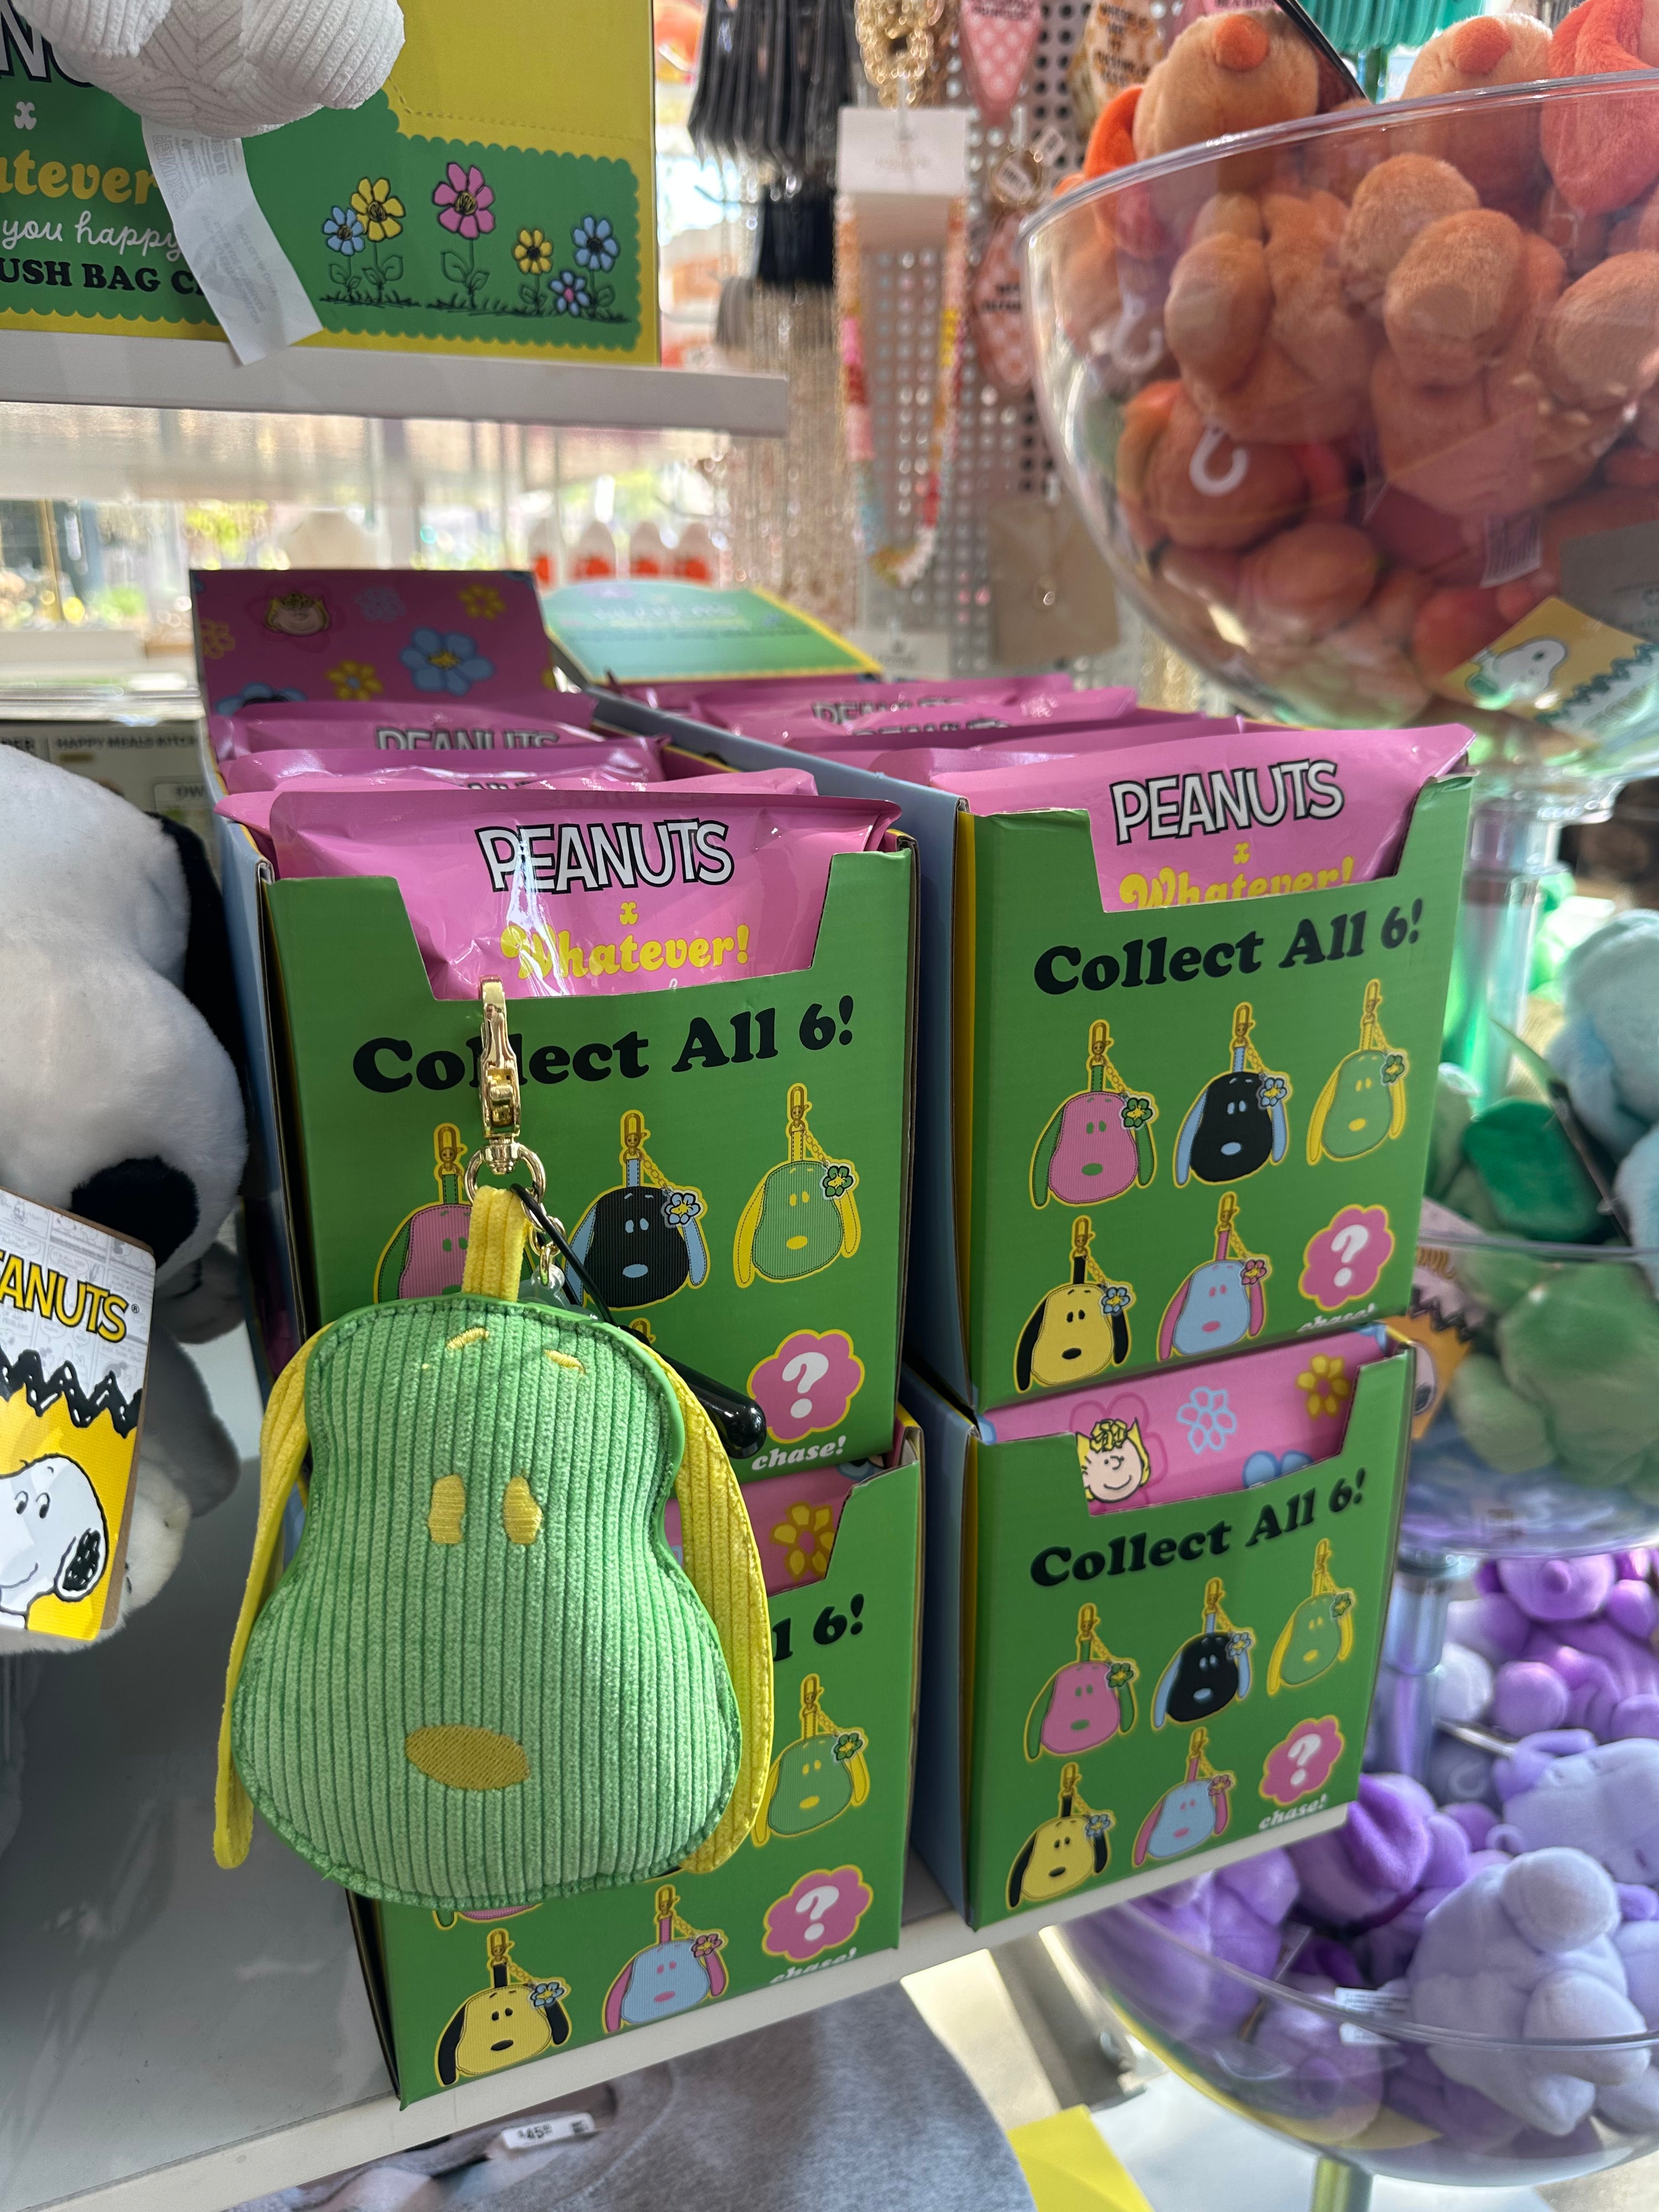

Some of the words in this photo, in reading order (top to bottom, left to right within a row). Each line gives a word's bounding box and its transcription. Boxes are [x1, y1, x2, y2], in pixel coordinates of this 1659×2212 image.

[2, 220, 62, 249] you
[75, 210, 182, 262] happy
[82, 263, 160, 292] BAG
[171, 270, 204, 295] C
[1109, 758, 1344, 846] PEANUTS
[475, 818, 734, 895] PEANUTS
[1119, 855, 1354, 910] Whatever!
[501, 924, 749, 979] Whatever!
[1034, 930, 1264, 995] Collect
[1279, 910, 1366, 968] All
[1381, 899, 1422, 950] 6!
[671, 1007, 778, 1073] All
[799, 995, 854, 1051] 6!
[0, 1248, 139, 1343] ANUTS®
[752, 1435, 846, 1470] chase!
[1030, 1520, 1232, 1587] Collect
[1245, 1487, 1315, 1546] All
[1329, 1467, 1365, 1512] 6!
[813, 1593, 864, 1645] 6!
[1259, 1793, 1327, 1830] chase!
